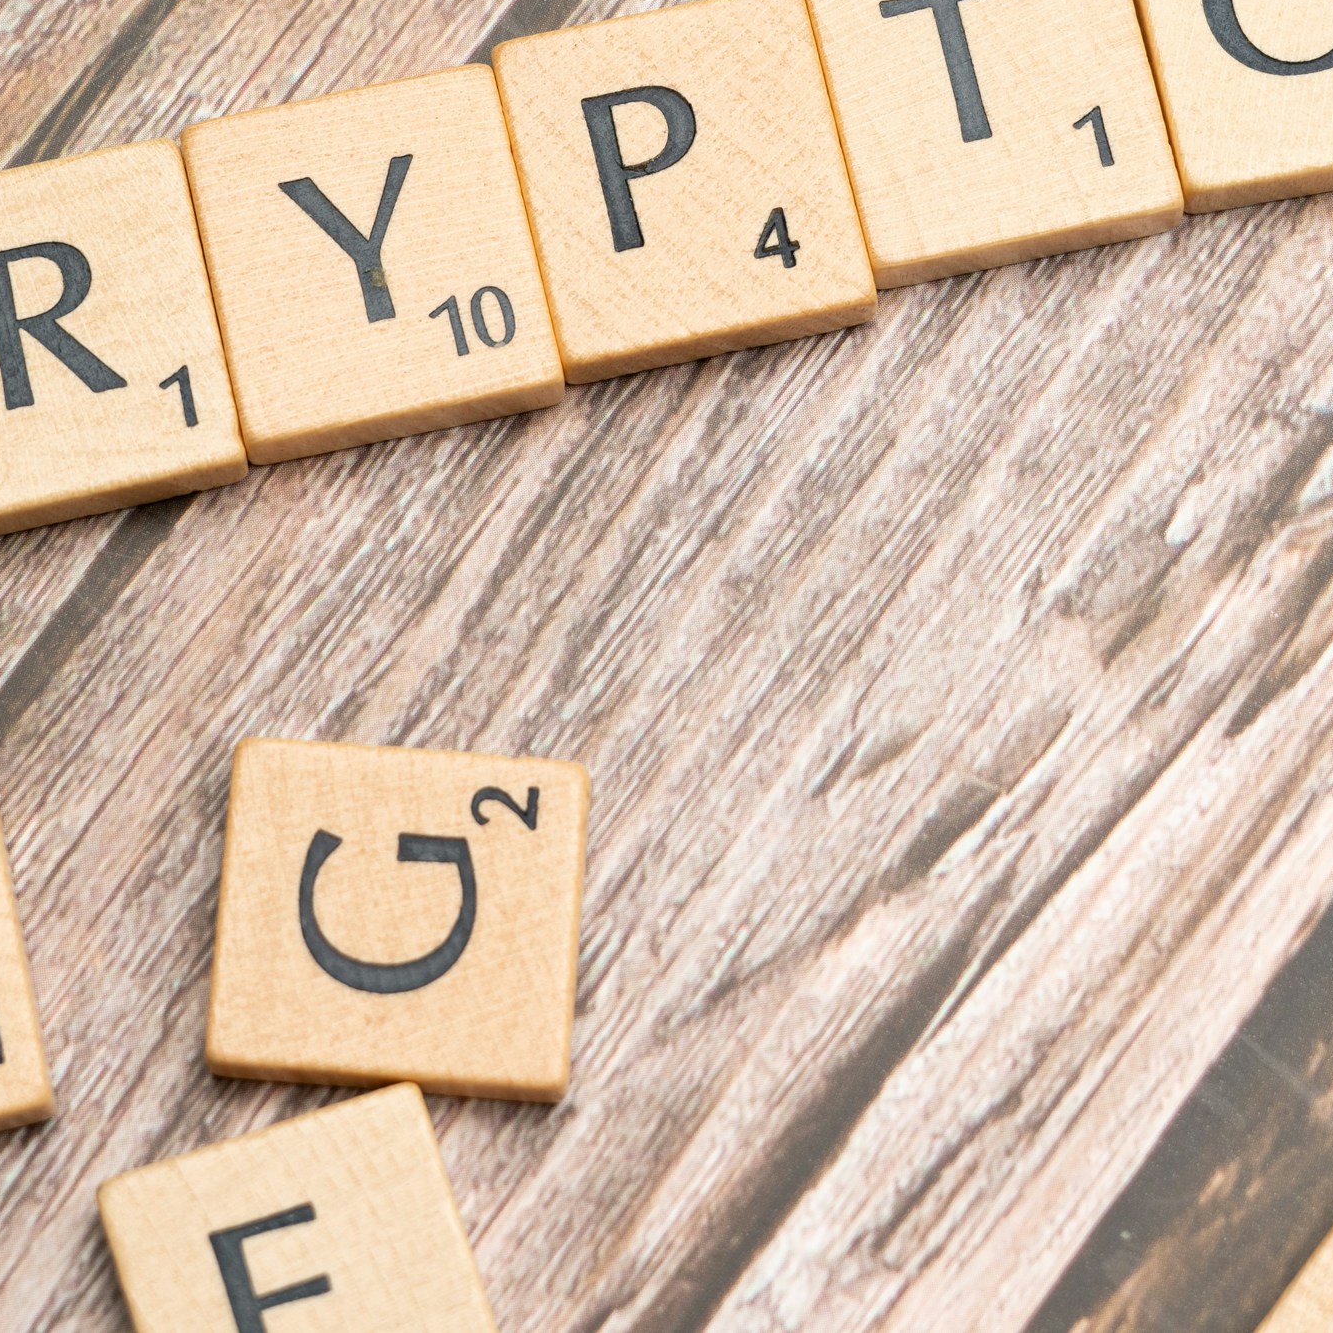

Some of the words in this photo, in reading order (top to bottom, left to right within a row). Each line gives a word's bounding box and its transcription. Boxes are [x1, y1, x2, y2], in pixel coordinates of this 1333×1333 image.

[159, 365, 199, 427] 1
[428, 286, 516, 356] 10
[754, 207, 800, 268] 4
[1072, 106, 1115, 167] 1
[298, 829, 477, 995] G
[470, 786, 540, 831] 2
